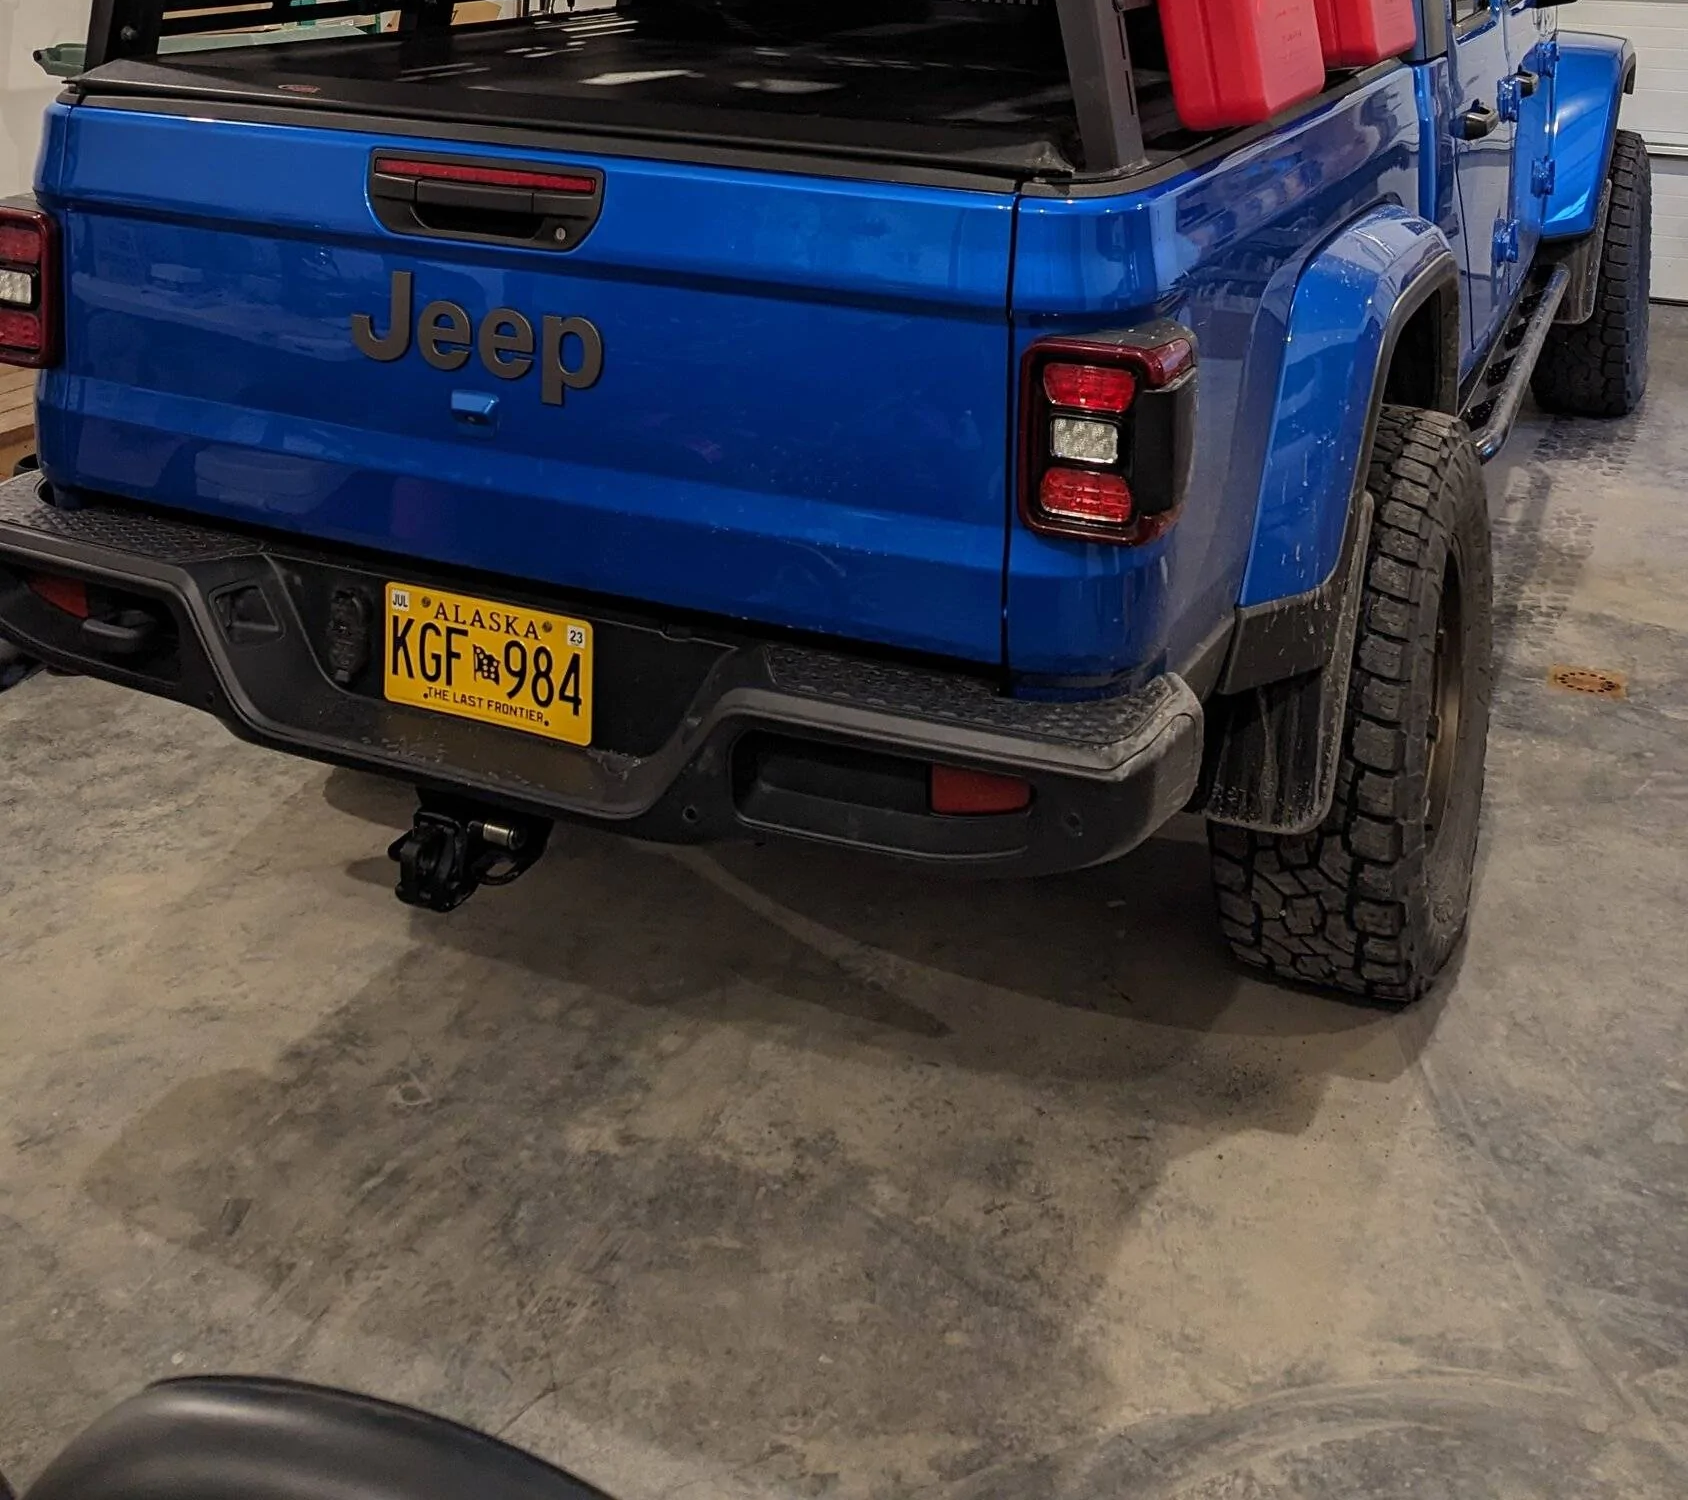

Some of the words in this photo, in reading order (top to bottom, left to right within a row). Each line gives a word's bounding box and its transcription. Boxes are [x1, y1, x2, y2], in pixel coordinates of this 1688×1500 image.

[351, 271, 602, 405] Jeep
[392, 592, 408, 608] JUL
[434, 602, 541, 640] ALASKA
[569, 629, 583, 644] 23
[392, 615, 468, 686] KGF
[504, 640, 582, 716] 984
[427, 687, 449, 701] THE
[453, 692, 483, 707] LAST
[487, 700, 543, 722] FRONTIER
